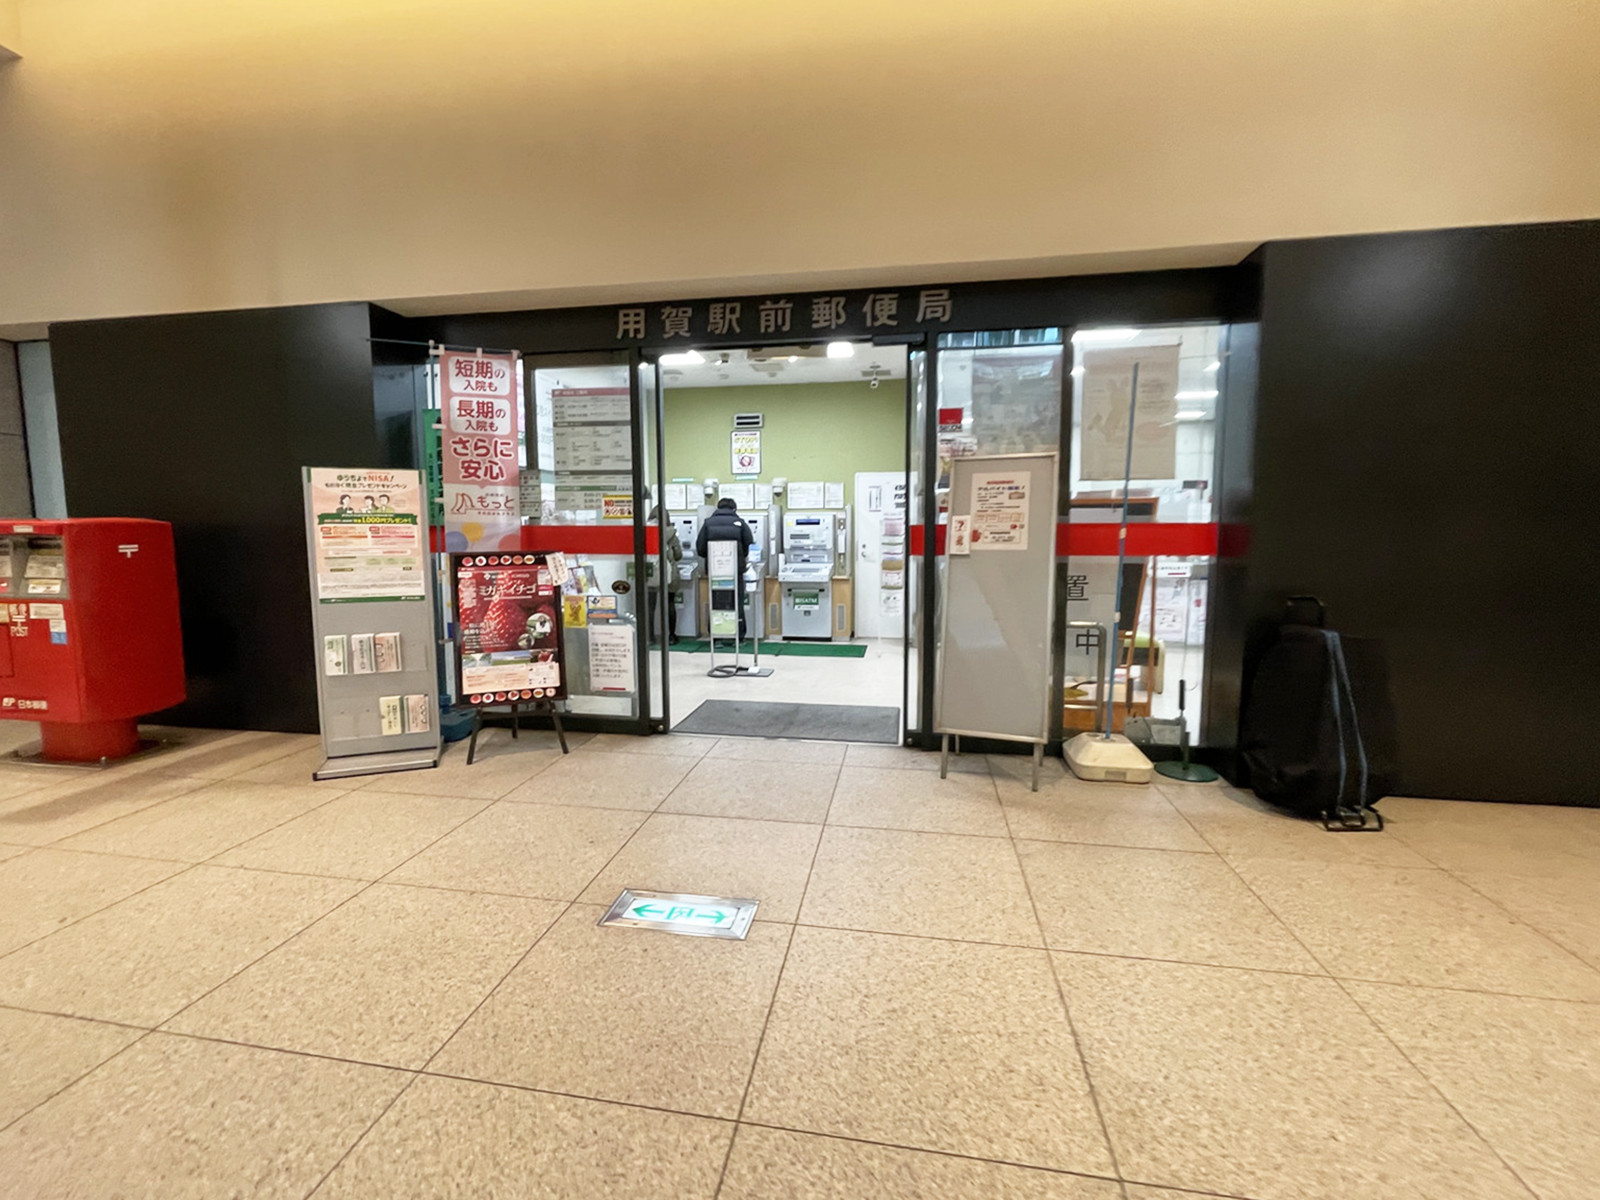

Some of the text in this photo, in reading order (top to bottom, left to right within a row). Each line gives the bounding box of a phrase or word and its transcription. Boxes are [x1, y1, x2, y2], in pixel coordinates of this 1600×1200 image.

[616, 289, 953, 340] 用賀駅前郵便局
[455, 358, 505, 379] 短期の
[464, 379, 497, 392] 入院も
[457, 399, 506, 420] 長期の
[465, 419, 498, 432] 入院も
[451, 437, 513, 459] さらに
[461, 459, 504, 480] 安心
[477, 495, 514, 509] もっと
[604, 499, 614, 507] NO
[10, 626, 28, 637] POST
[1076, 629, 1099, 655] 中
